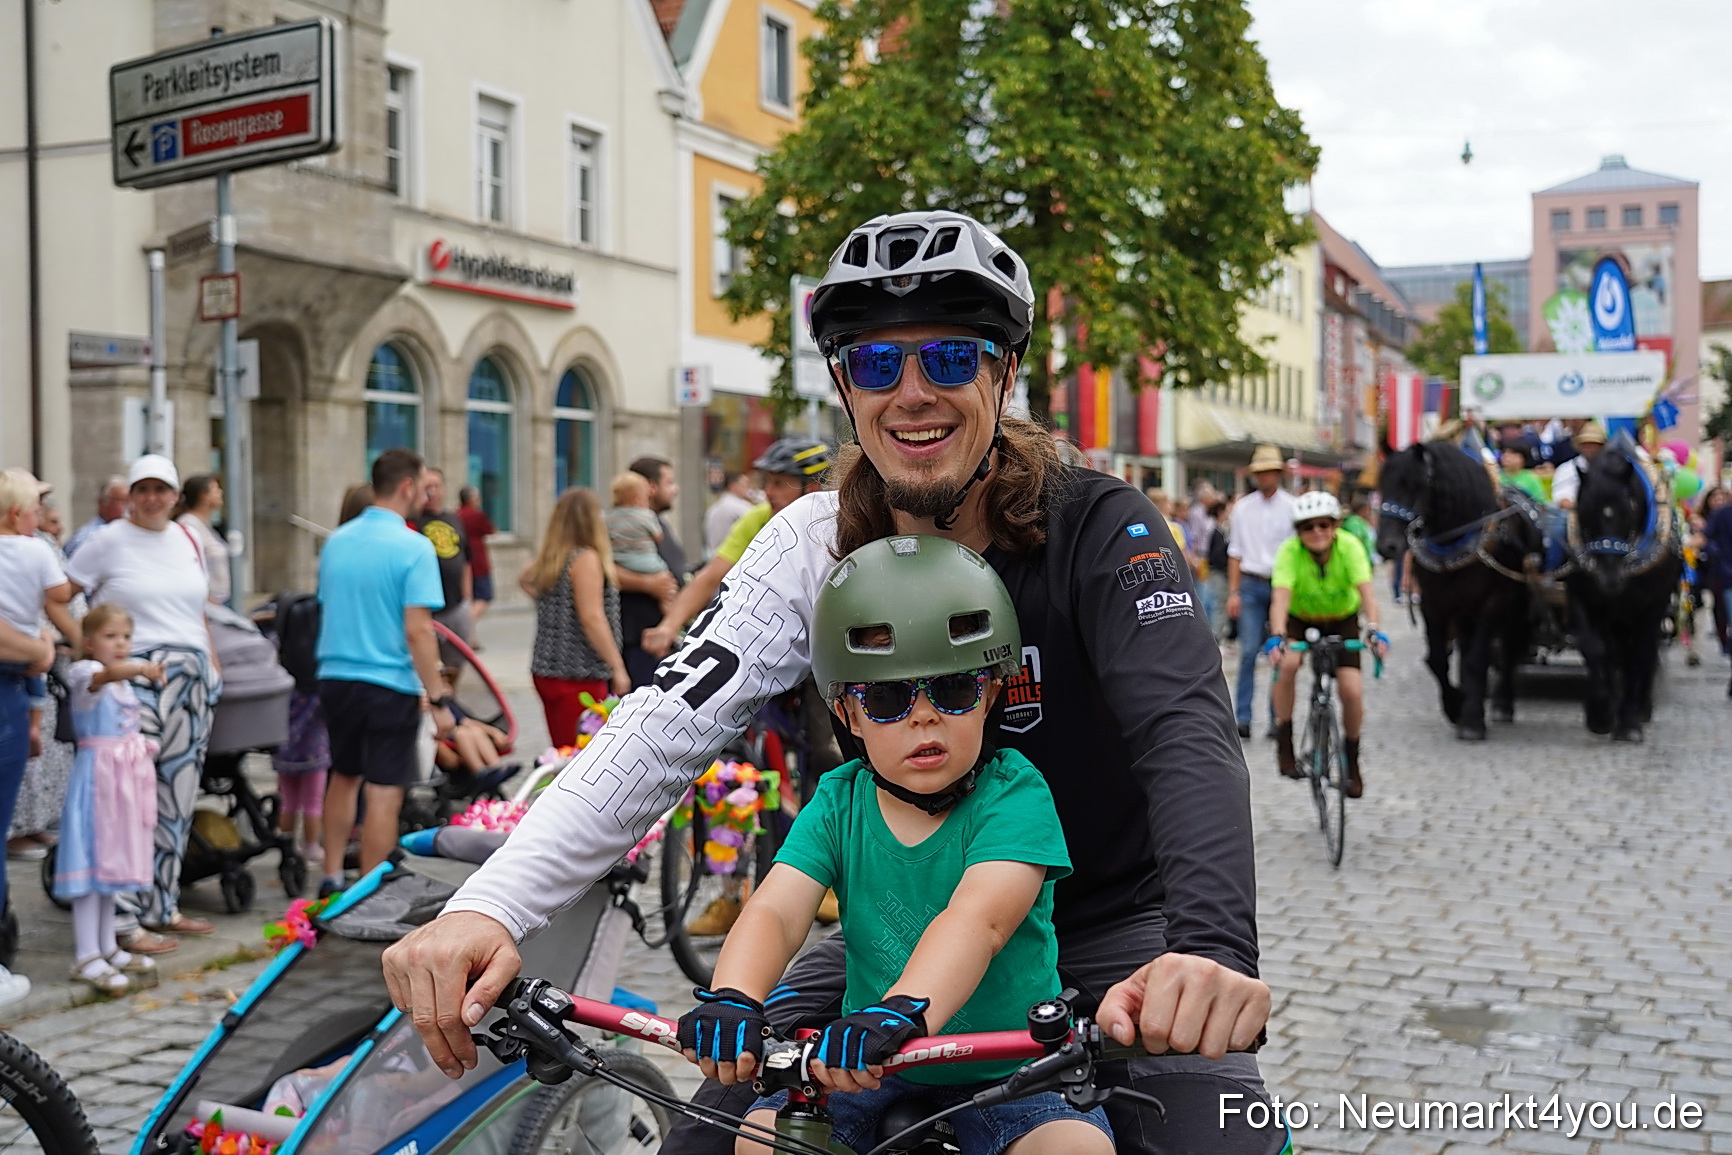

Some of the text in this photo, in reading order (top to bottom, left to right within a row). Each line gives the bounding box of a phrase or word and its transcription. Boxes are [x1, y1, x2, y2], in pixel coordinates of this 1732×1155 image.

[142, 51, 282, 101] Parkleitsystem
[190, 109, 284, 145] Rosengasse
[1153, 593, 1187, 609] DAV
[1138, 610, 1165, 621] Deutscher
[945, 1045, 974, 1058] 762
